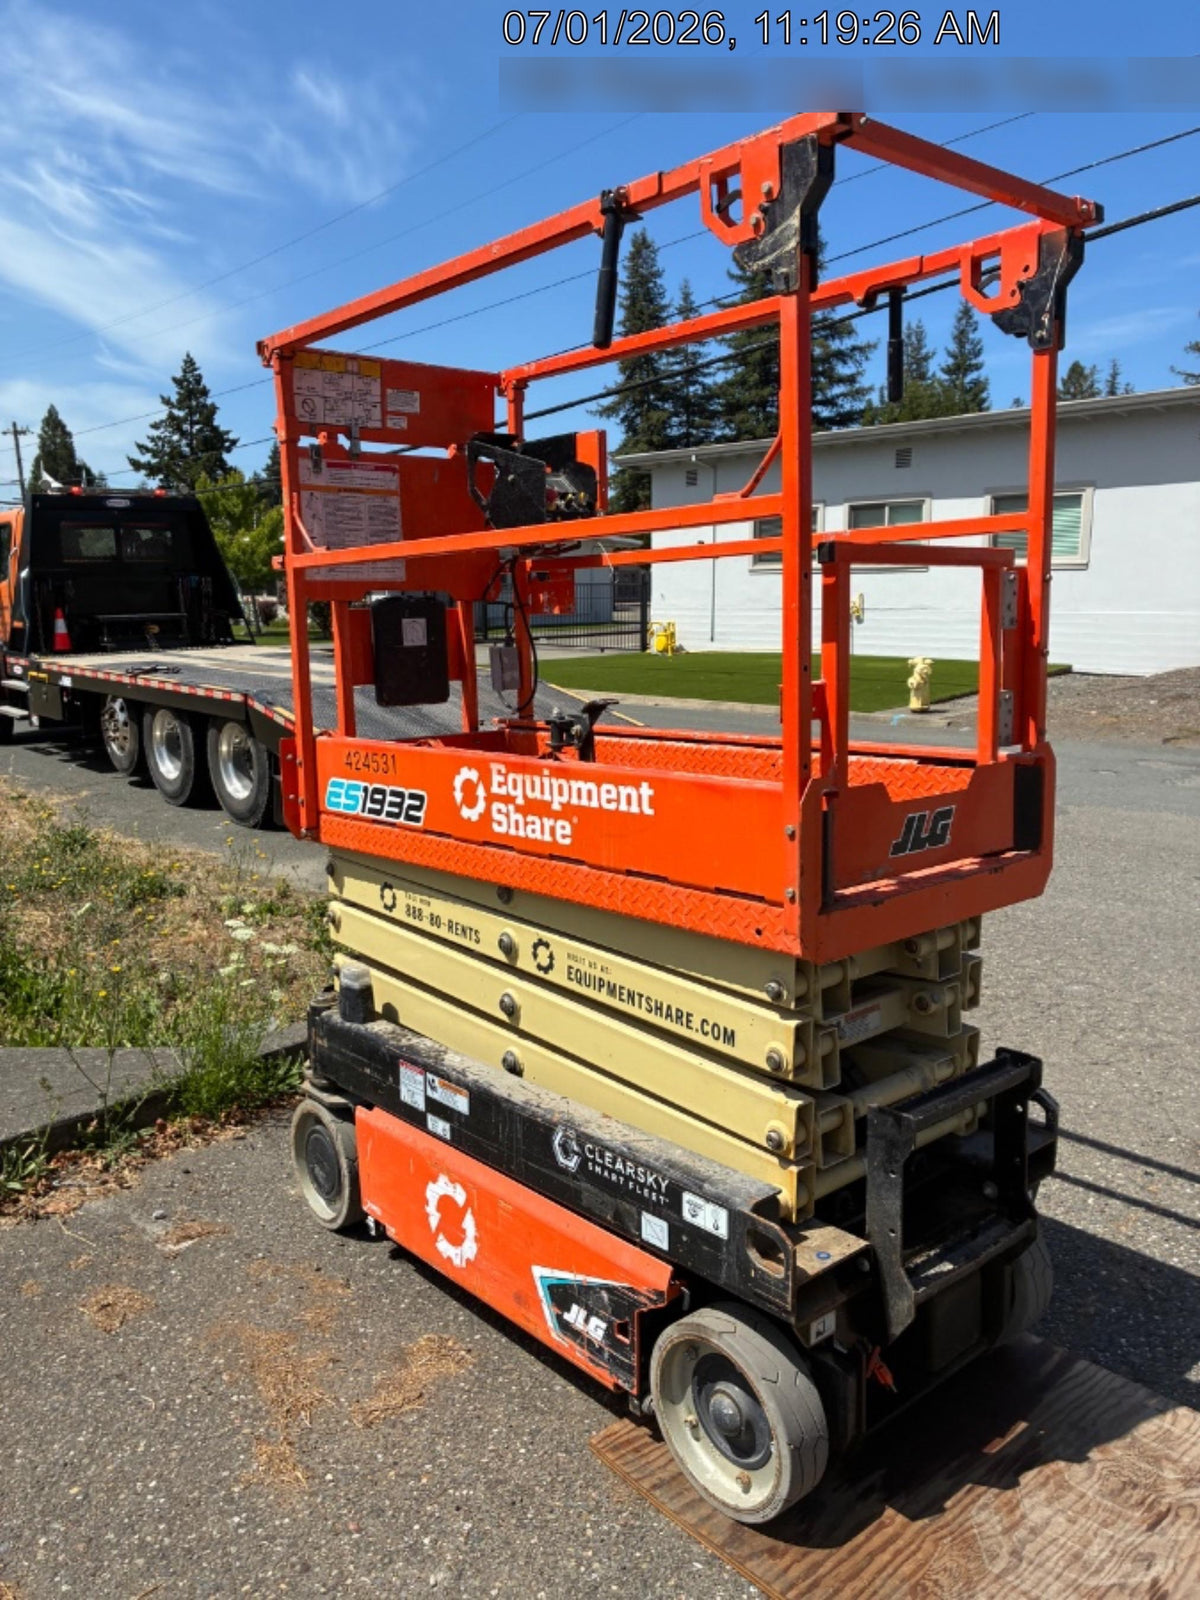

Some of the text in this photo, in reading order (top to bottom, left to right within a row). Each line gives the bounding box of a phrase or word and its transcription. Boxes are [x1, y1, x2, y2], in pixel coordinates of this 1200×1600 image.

[344, 750, 397, 776] 424531
[326, 778, 427, 826] ES1932
[490, 762, 655, 816] Equipment
[491, 801, 573, 846] Share
[889, 805, 956, 857] JLG
[566, 964, 736, 1048] EQUIPMENTSHARE.COM
[584, 1143, 670, 1195] CLEARSKY
[587, 1162, 667, 1206] SMART FLEET
[563, 1303, 607, 1341] JLG
